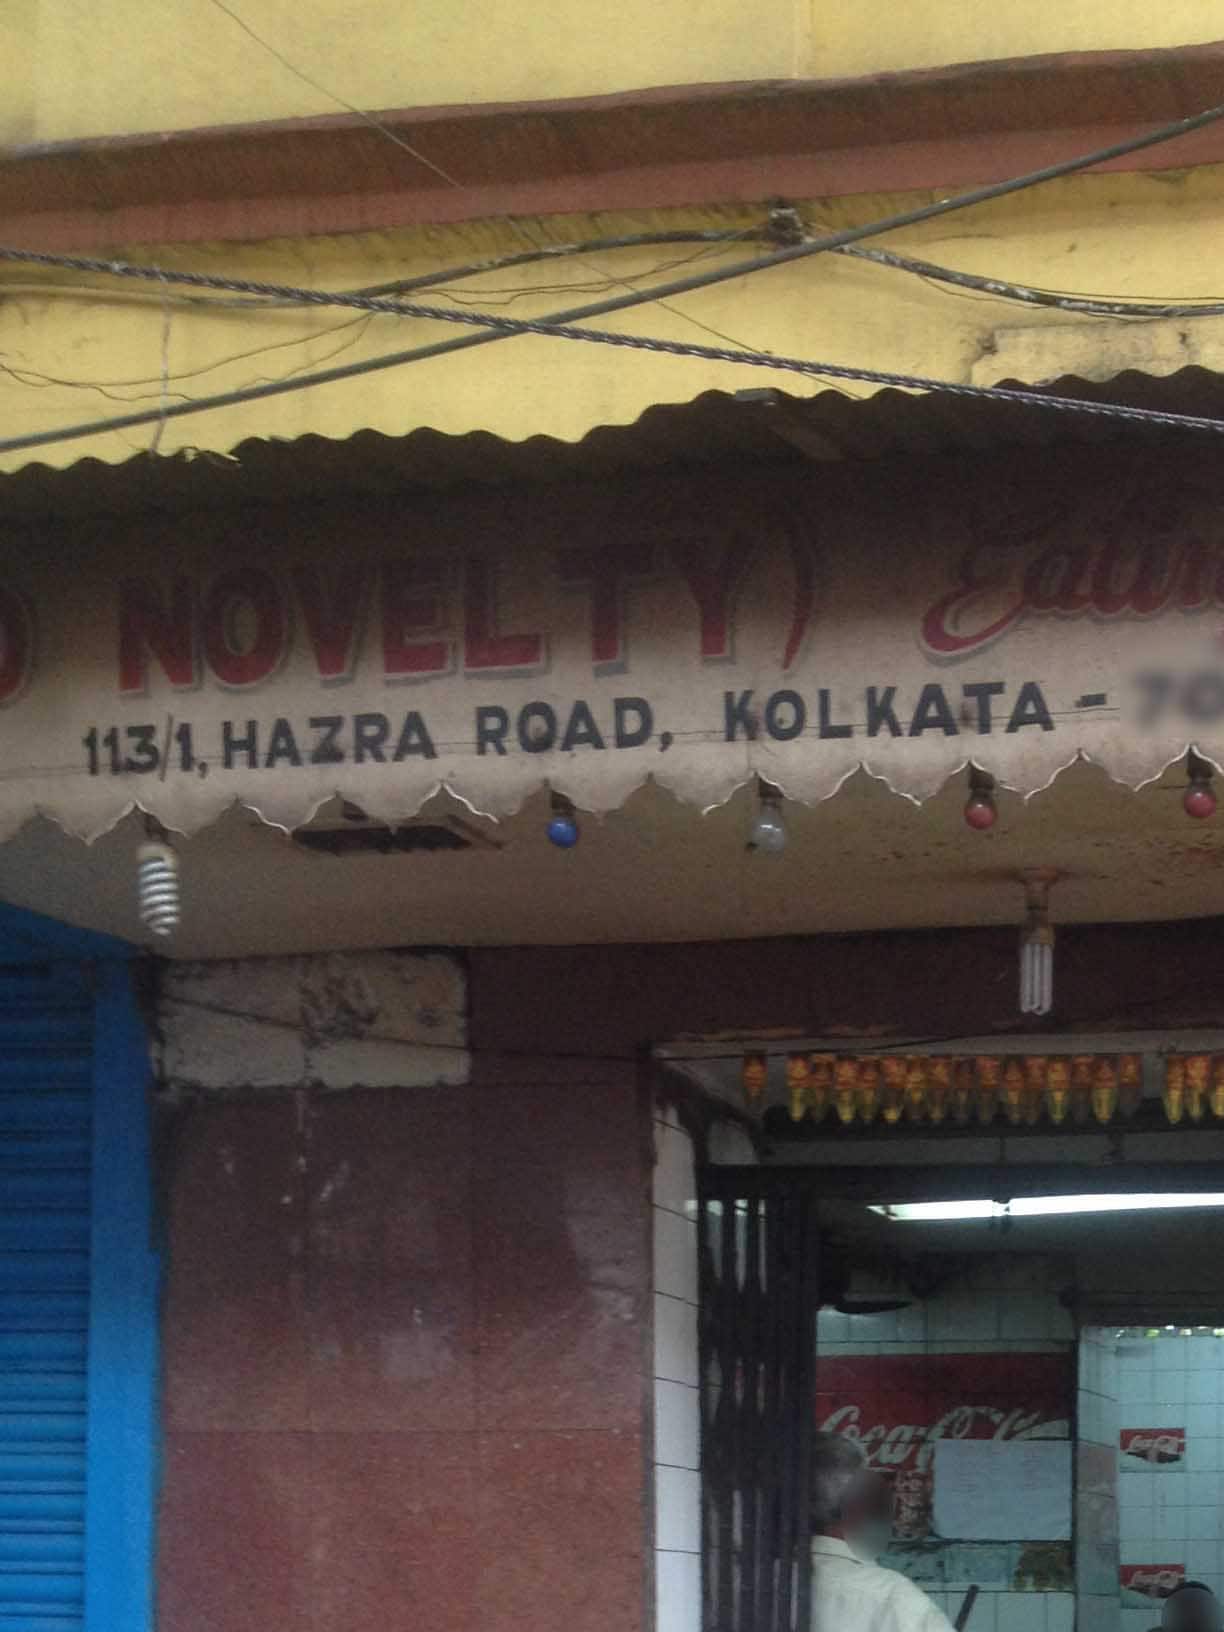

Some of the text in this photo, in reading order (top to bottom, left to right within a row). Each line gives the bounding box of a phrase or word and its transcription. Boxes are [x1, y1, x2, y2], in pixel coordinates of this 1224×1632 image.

[222, 710, 436, 769] HAZRA
[476, 697, 673, 754] ROAD,
[723, 680, 1055, 742] KOLKATA
